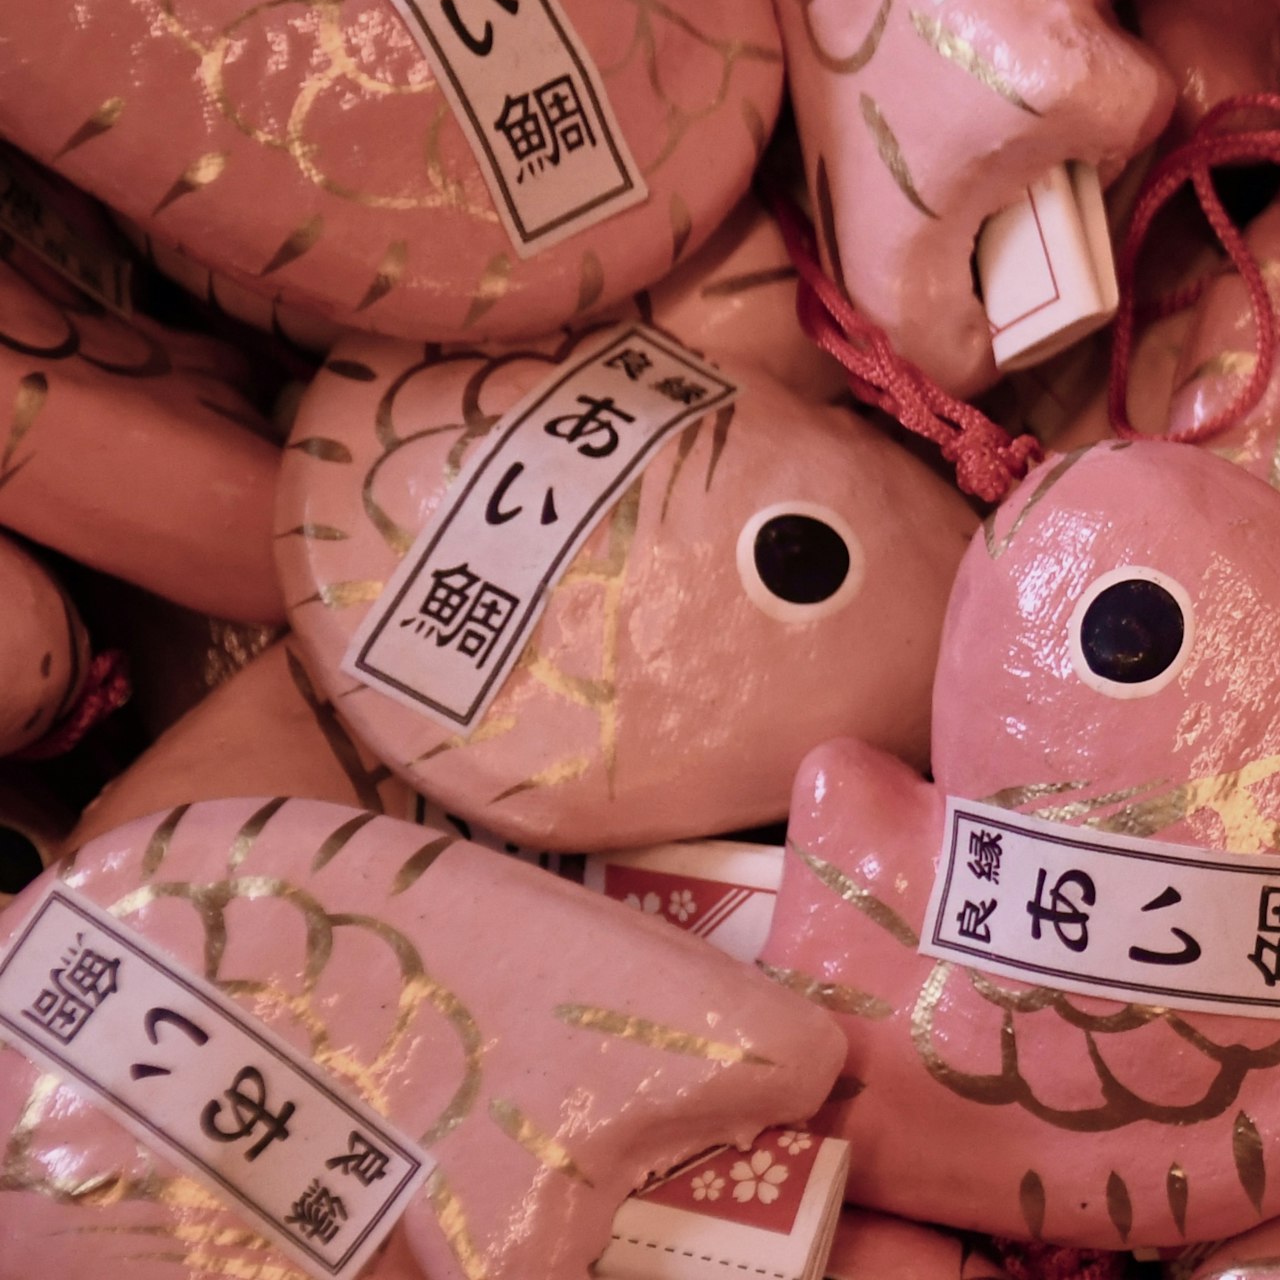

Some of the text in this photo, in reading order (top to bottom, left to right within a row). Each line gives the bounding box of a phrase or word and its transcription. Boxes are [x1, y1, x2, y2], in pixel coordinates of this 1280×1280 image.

[603, 348, 707, 404] 良縁
[401, 394, 635, 671] あい鯛
[957, 829, 1004, 944] 良縁
[22, 932, 298, 1162] あい鯛
[284, 1130, 393, 1245] 良縁
